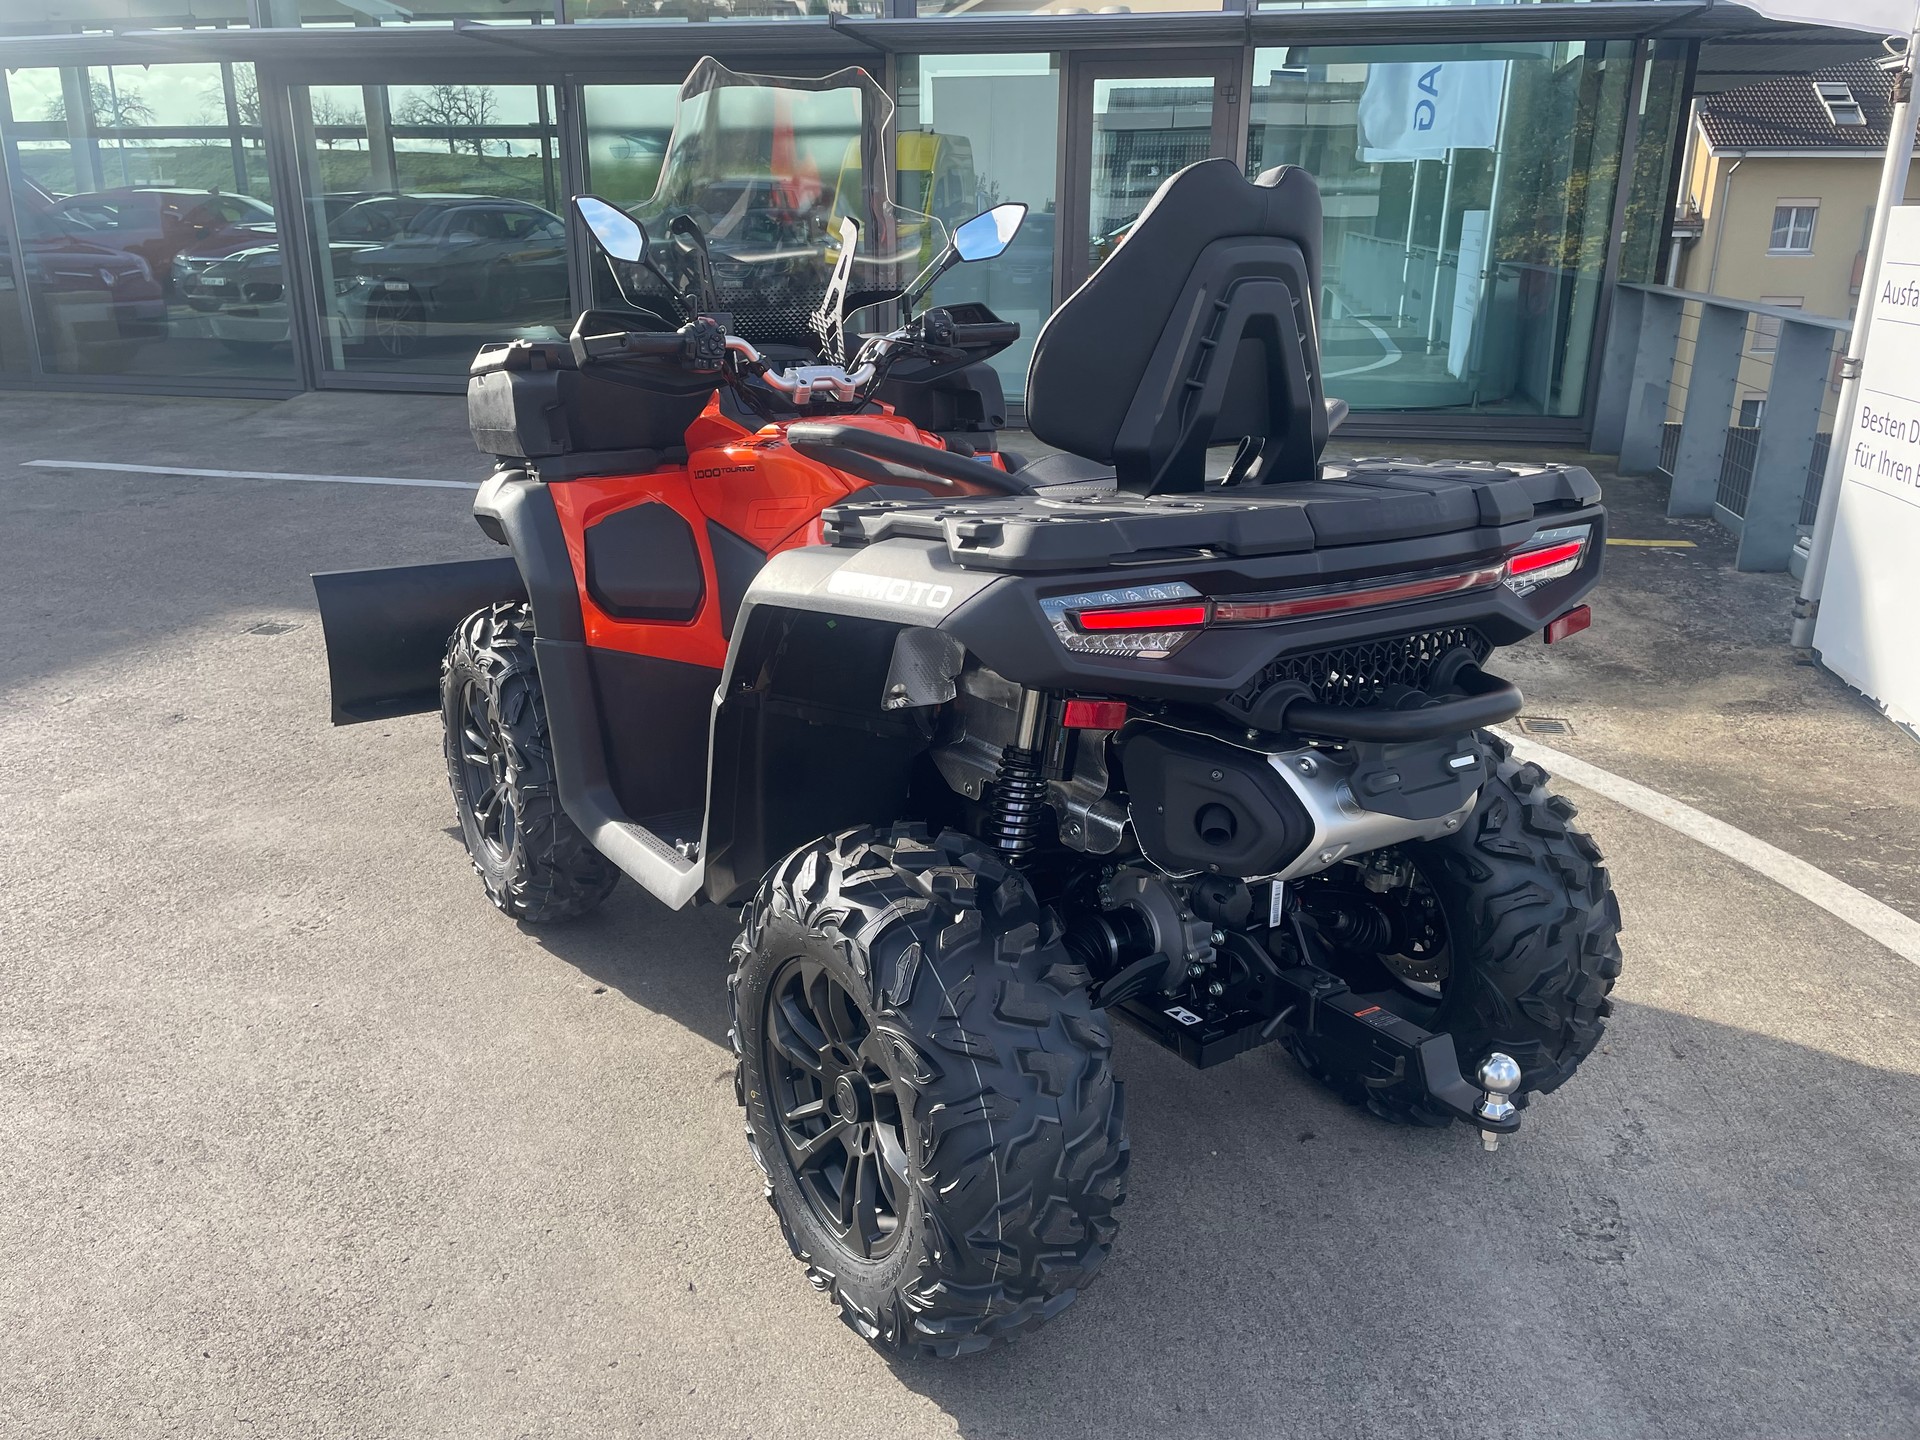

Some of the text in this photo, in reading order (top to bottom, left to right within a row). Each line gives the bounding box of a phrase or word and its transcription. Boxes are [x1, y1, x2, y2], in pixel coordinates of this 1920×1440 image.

[1861, 405, 1920, 446] Besten D
[693, 465, 755, 479] 1000 TOURING
[1853, 441, 1876, 470] für
[1877, 449, 1912, 485] Ihren
